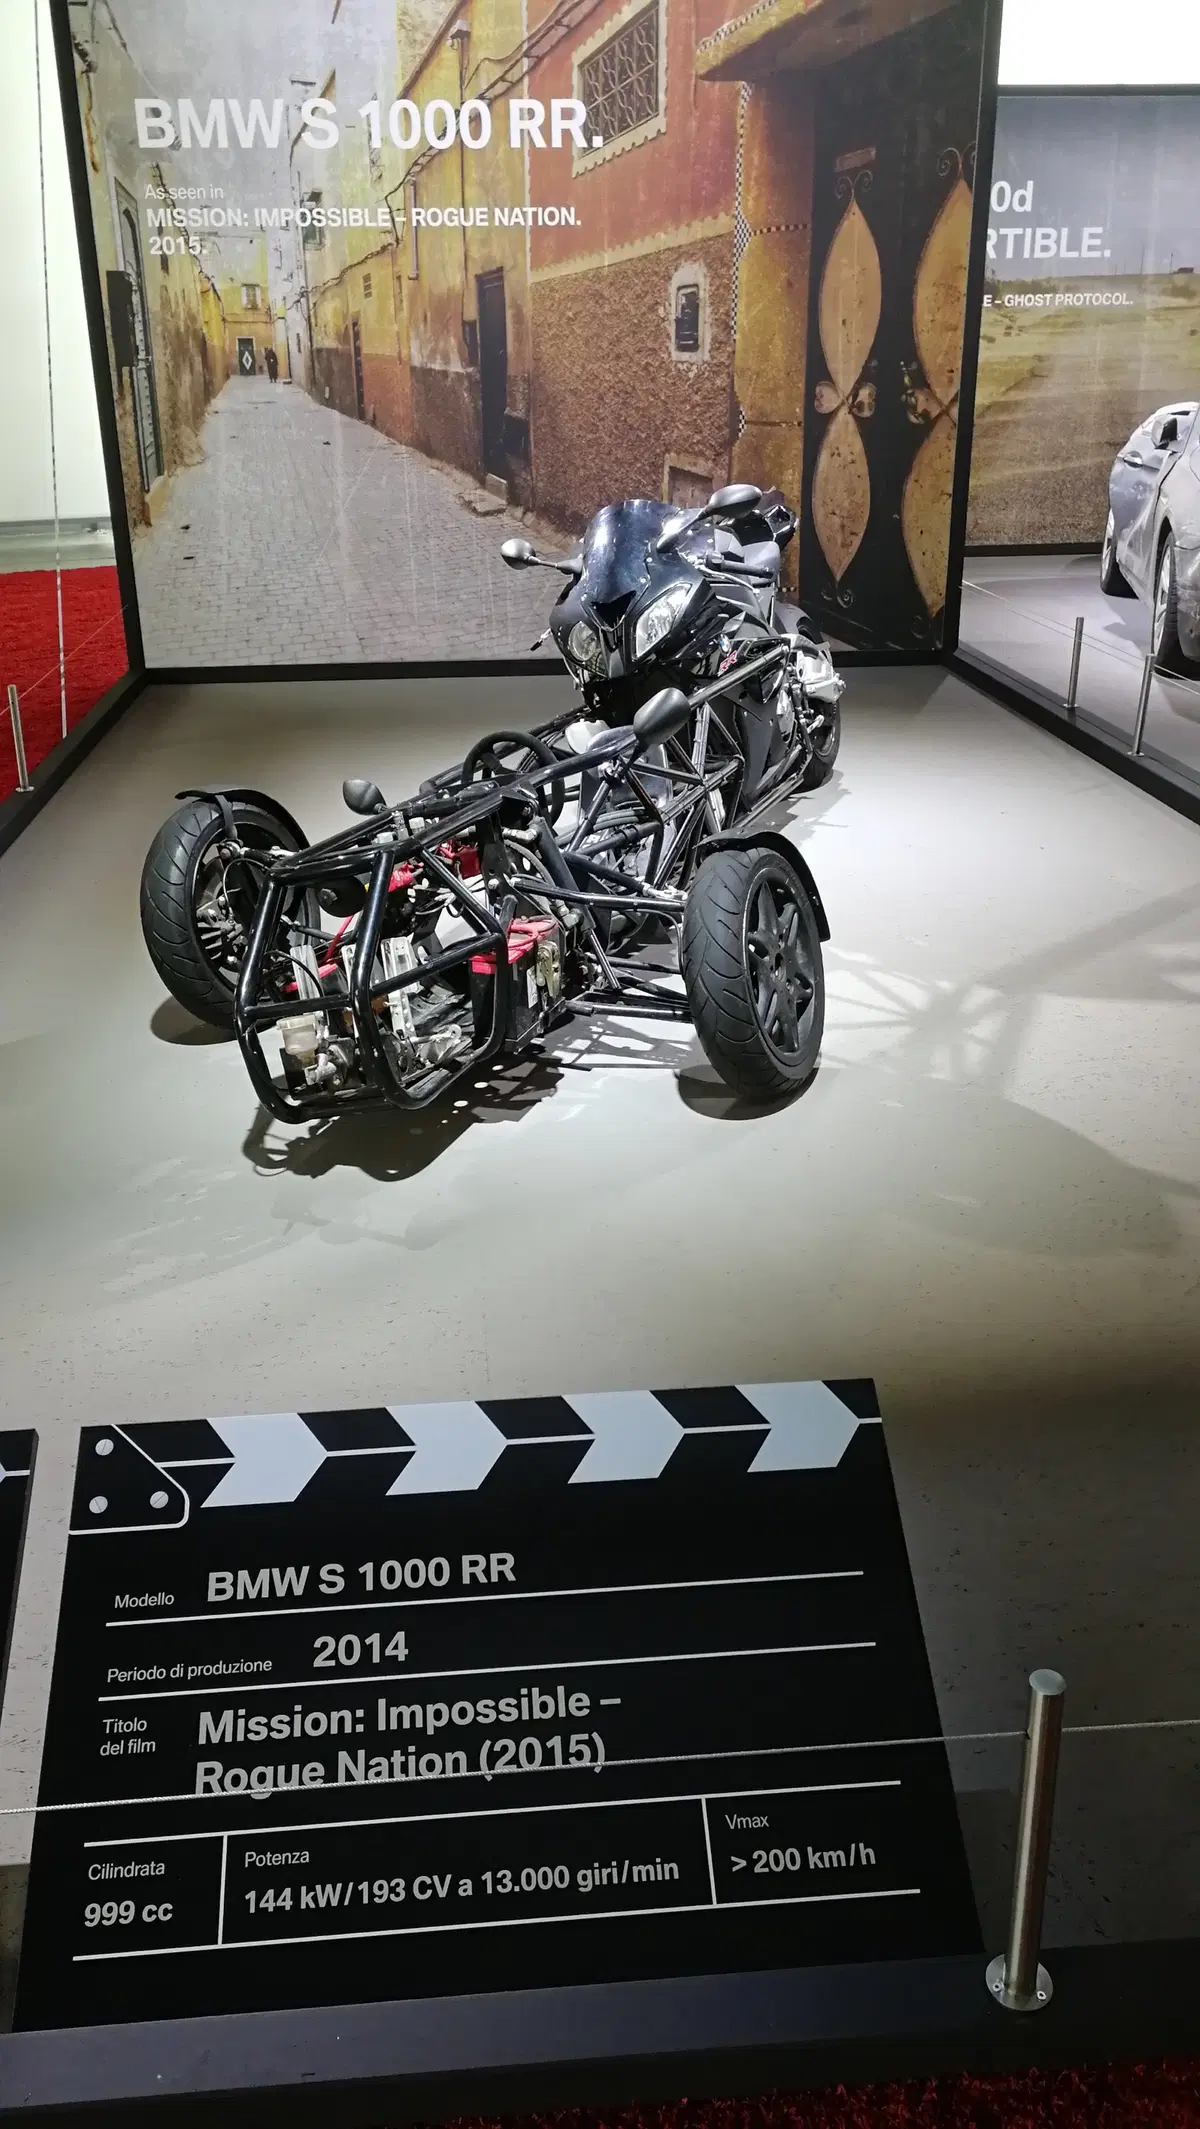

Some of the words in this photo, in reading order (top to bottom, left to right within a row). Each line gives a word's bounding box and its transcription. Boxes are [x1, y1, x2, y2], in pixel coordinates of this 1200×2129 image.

[134, 98, 283, 149] BMW
[301, 98, 339, 149] S
[358, 98, 492, 149] 1000
[508, 98, 604, 149] RR.
[144, 184, 166, 200] As
[170, 186, 206, 200] seen
[210, 184, 224, 200] in
[146, 207, 249, 228] MISSION:
[254, 207, 391, 228] IMPOSSIBLE
[411, 207, 489, 227] ROGUE
[494, 206, 582, 227] NATION.
[149, 236, 207, 255] 2015.
[1004, 294, 1053, 307] GHOST
[1055, 293, 1134, 305] PROTOCOL.
[207, 1565, 310, 1602] BMW
[318, 1563, 345, 1594] S
[358, 1556, 451, 1591] 1000
[461, 1552, 517, 1584] RR
[114, 1591, 175, 1609] Modello
[313, 1631, 409, 1668] 2014
[107, 1665, 167, 1683] Periodo
[169, 1663, 185, 1679] di
[187, 1658, 273, 1680] produzione
[102, 1716, 148, 1734] Titolo
[198, 1704, 365, 1745] Mission:
[377, 1685, 591, 1735] Impossible
[99, 1739, 125, 1756] del
[127, 1738, 156, 1754] film
[195, 1760, 325, 1800] Rogue
[337, 1746, 468, 1784] Nation
[479, 1731, 606, 1782] (2015)
[724, 1813, 769, 1830] Vmax
[244, 1850, 310, 1868] Potenza
[752, 1847, 801, 1874] 200
[807, 1842, 876, 1869] km/h
[88, 1861, 165, 1881] Cilindrata
[244, 1887, 293, 1914] 144
[412, 1873, 452, 1900] CV
[457, 1879, 473, 1897] a
[481, 1865, 570, 1894] 13.000
[576, 1857, 679, 1893] giri/min
[84, 1900, 136, 1928] 999
[141, 1902, 174, 1923] cc
